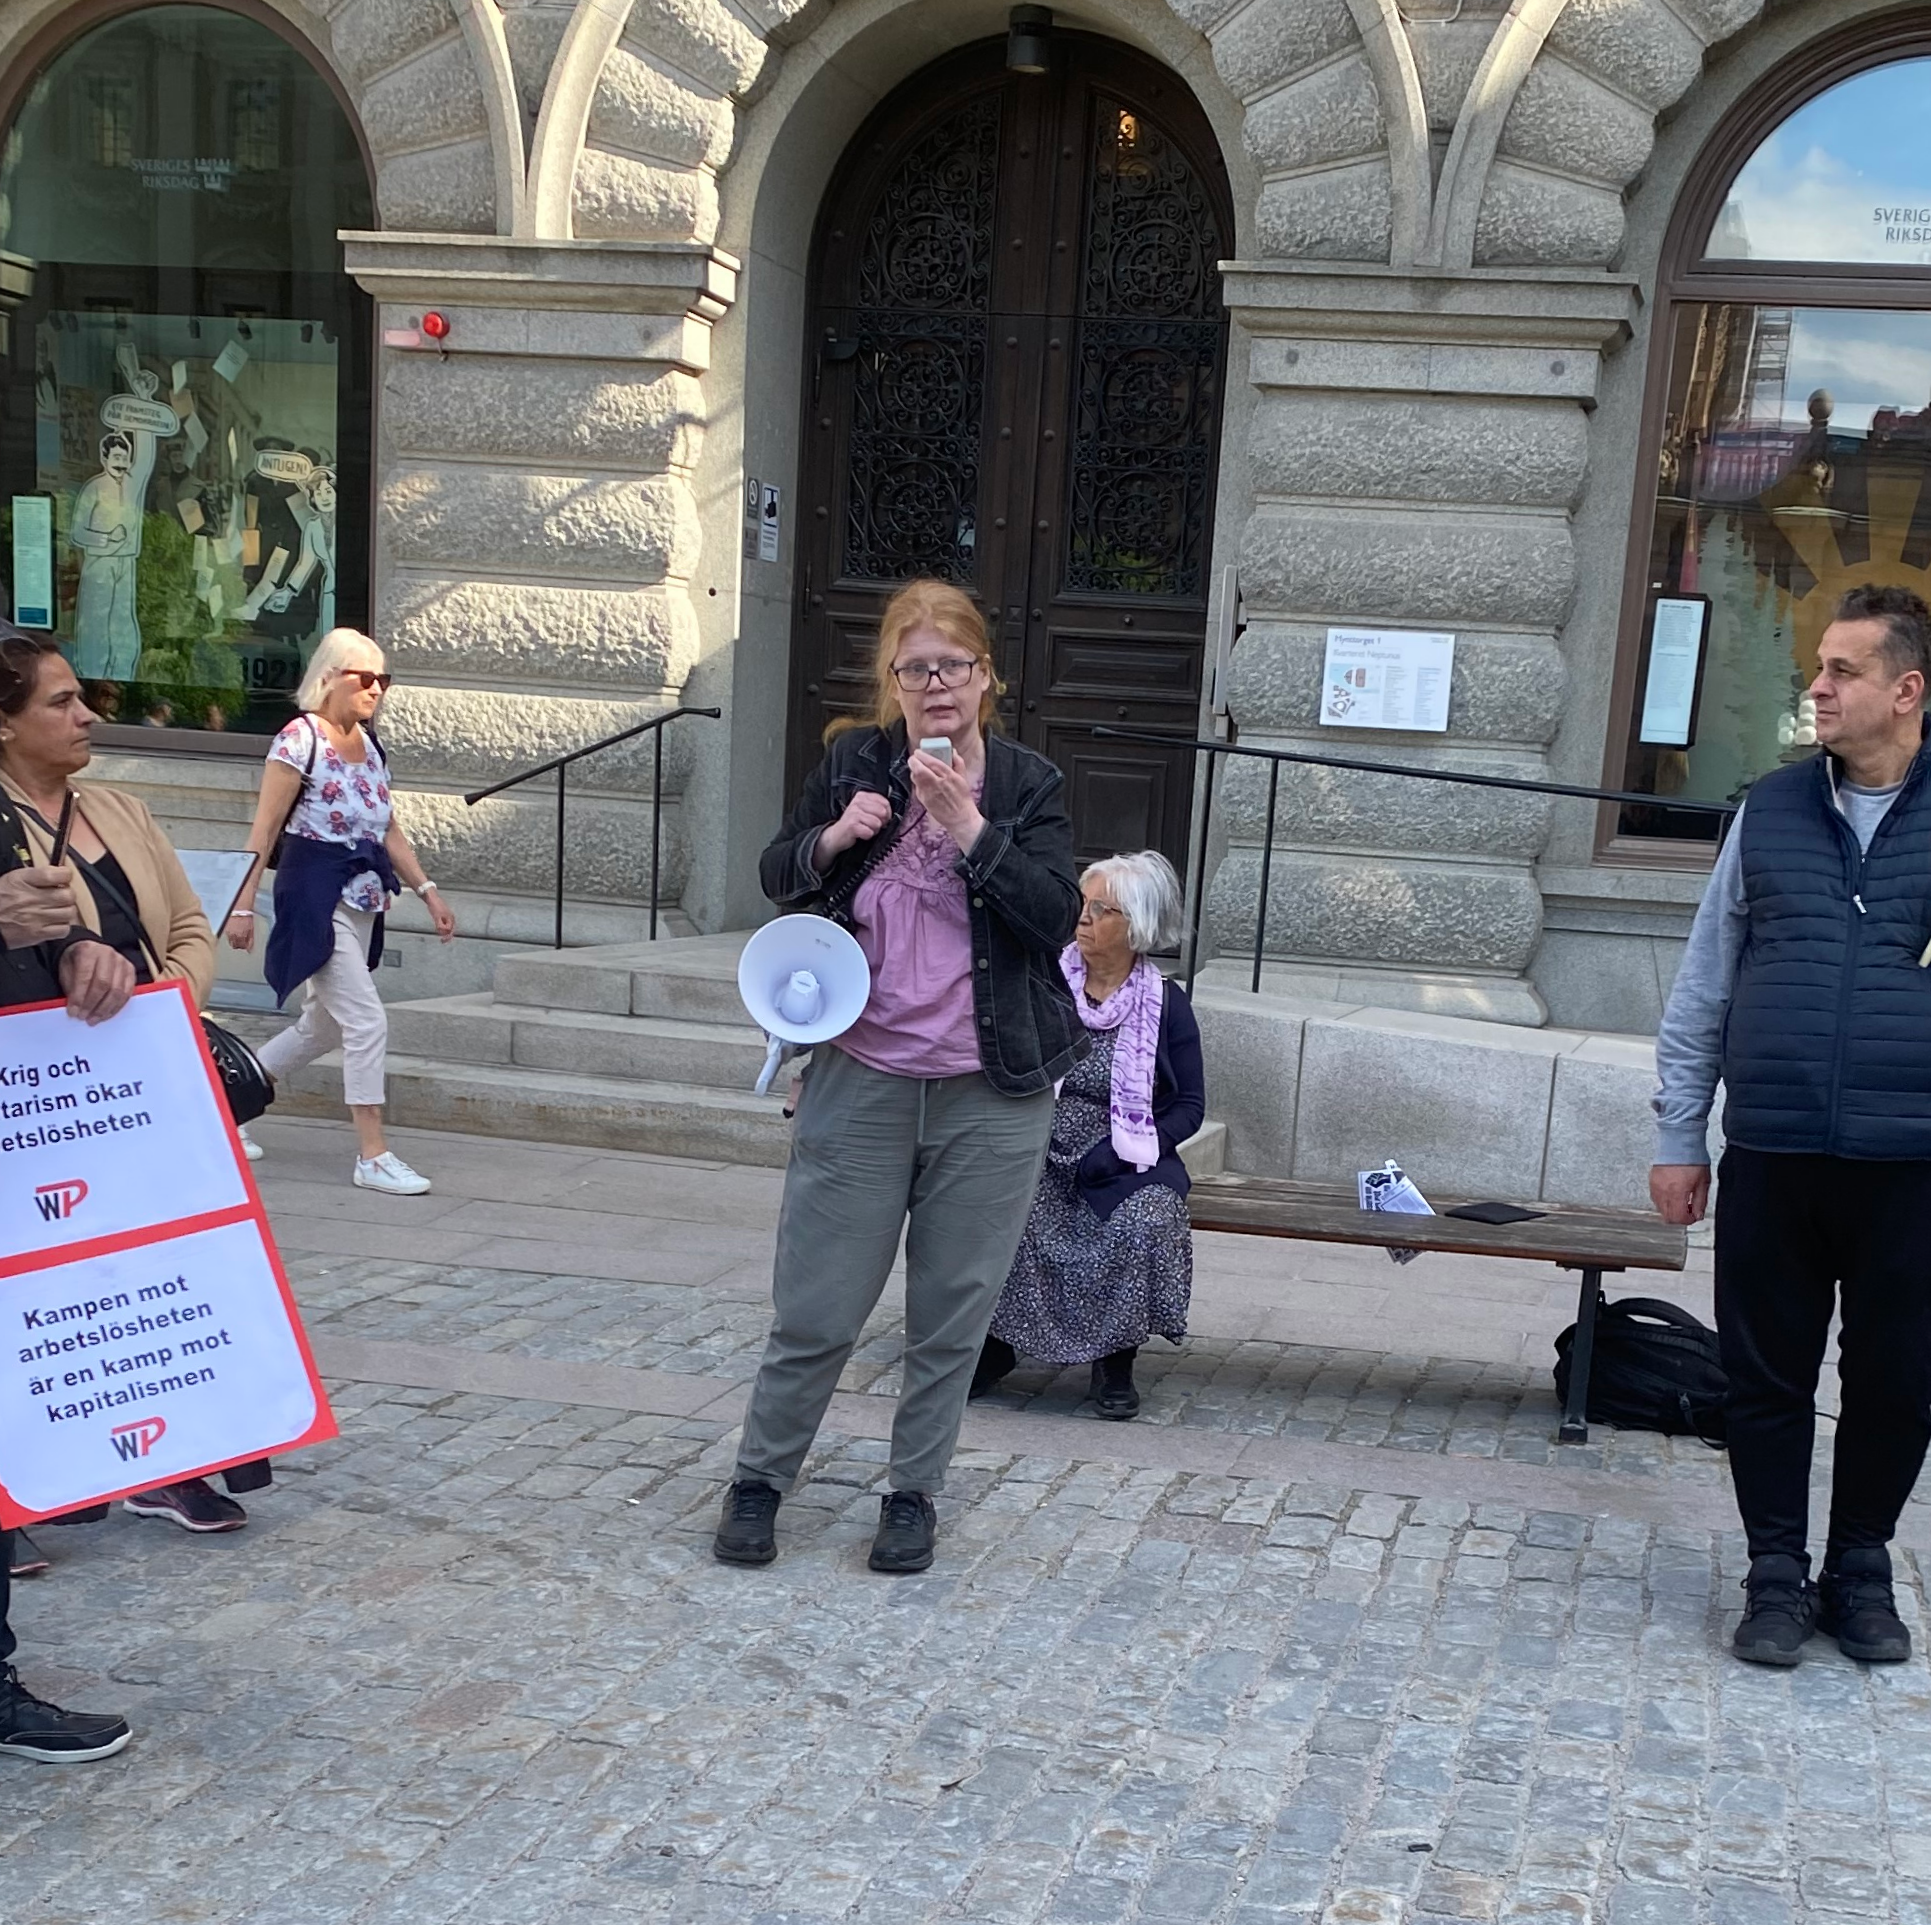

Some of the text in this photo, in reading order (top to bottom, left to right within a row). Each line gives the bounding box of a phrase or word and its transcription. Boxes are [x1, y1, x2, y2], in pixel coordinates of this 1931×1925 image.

[130, 159, 191, 172] SVERIGES
[142, 175, 200, 189] RIKSDAG
[1873, 207, 1931, 222] SVERIG
[47, 1055, 91, 1078] och
[85, 1081, 142, 1104] ökar
[23, 1274, 189, 1330] Kampen mot
[18, 1302, 214, 1363] arbetslösheten
[29, 1329, 232, 1395] är en kamp mot
[46, 1366, 215, 1422] kapitalismen
